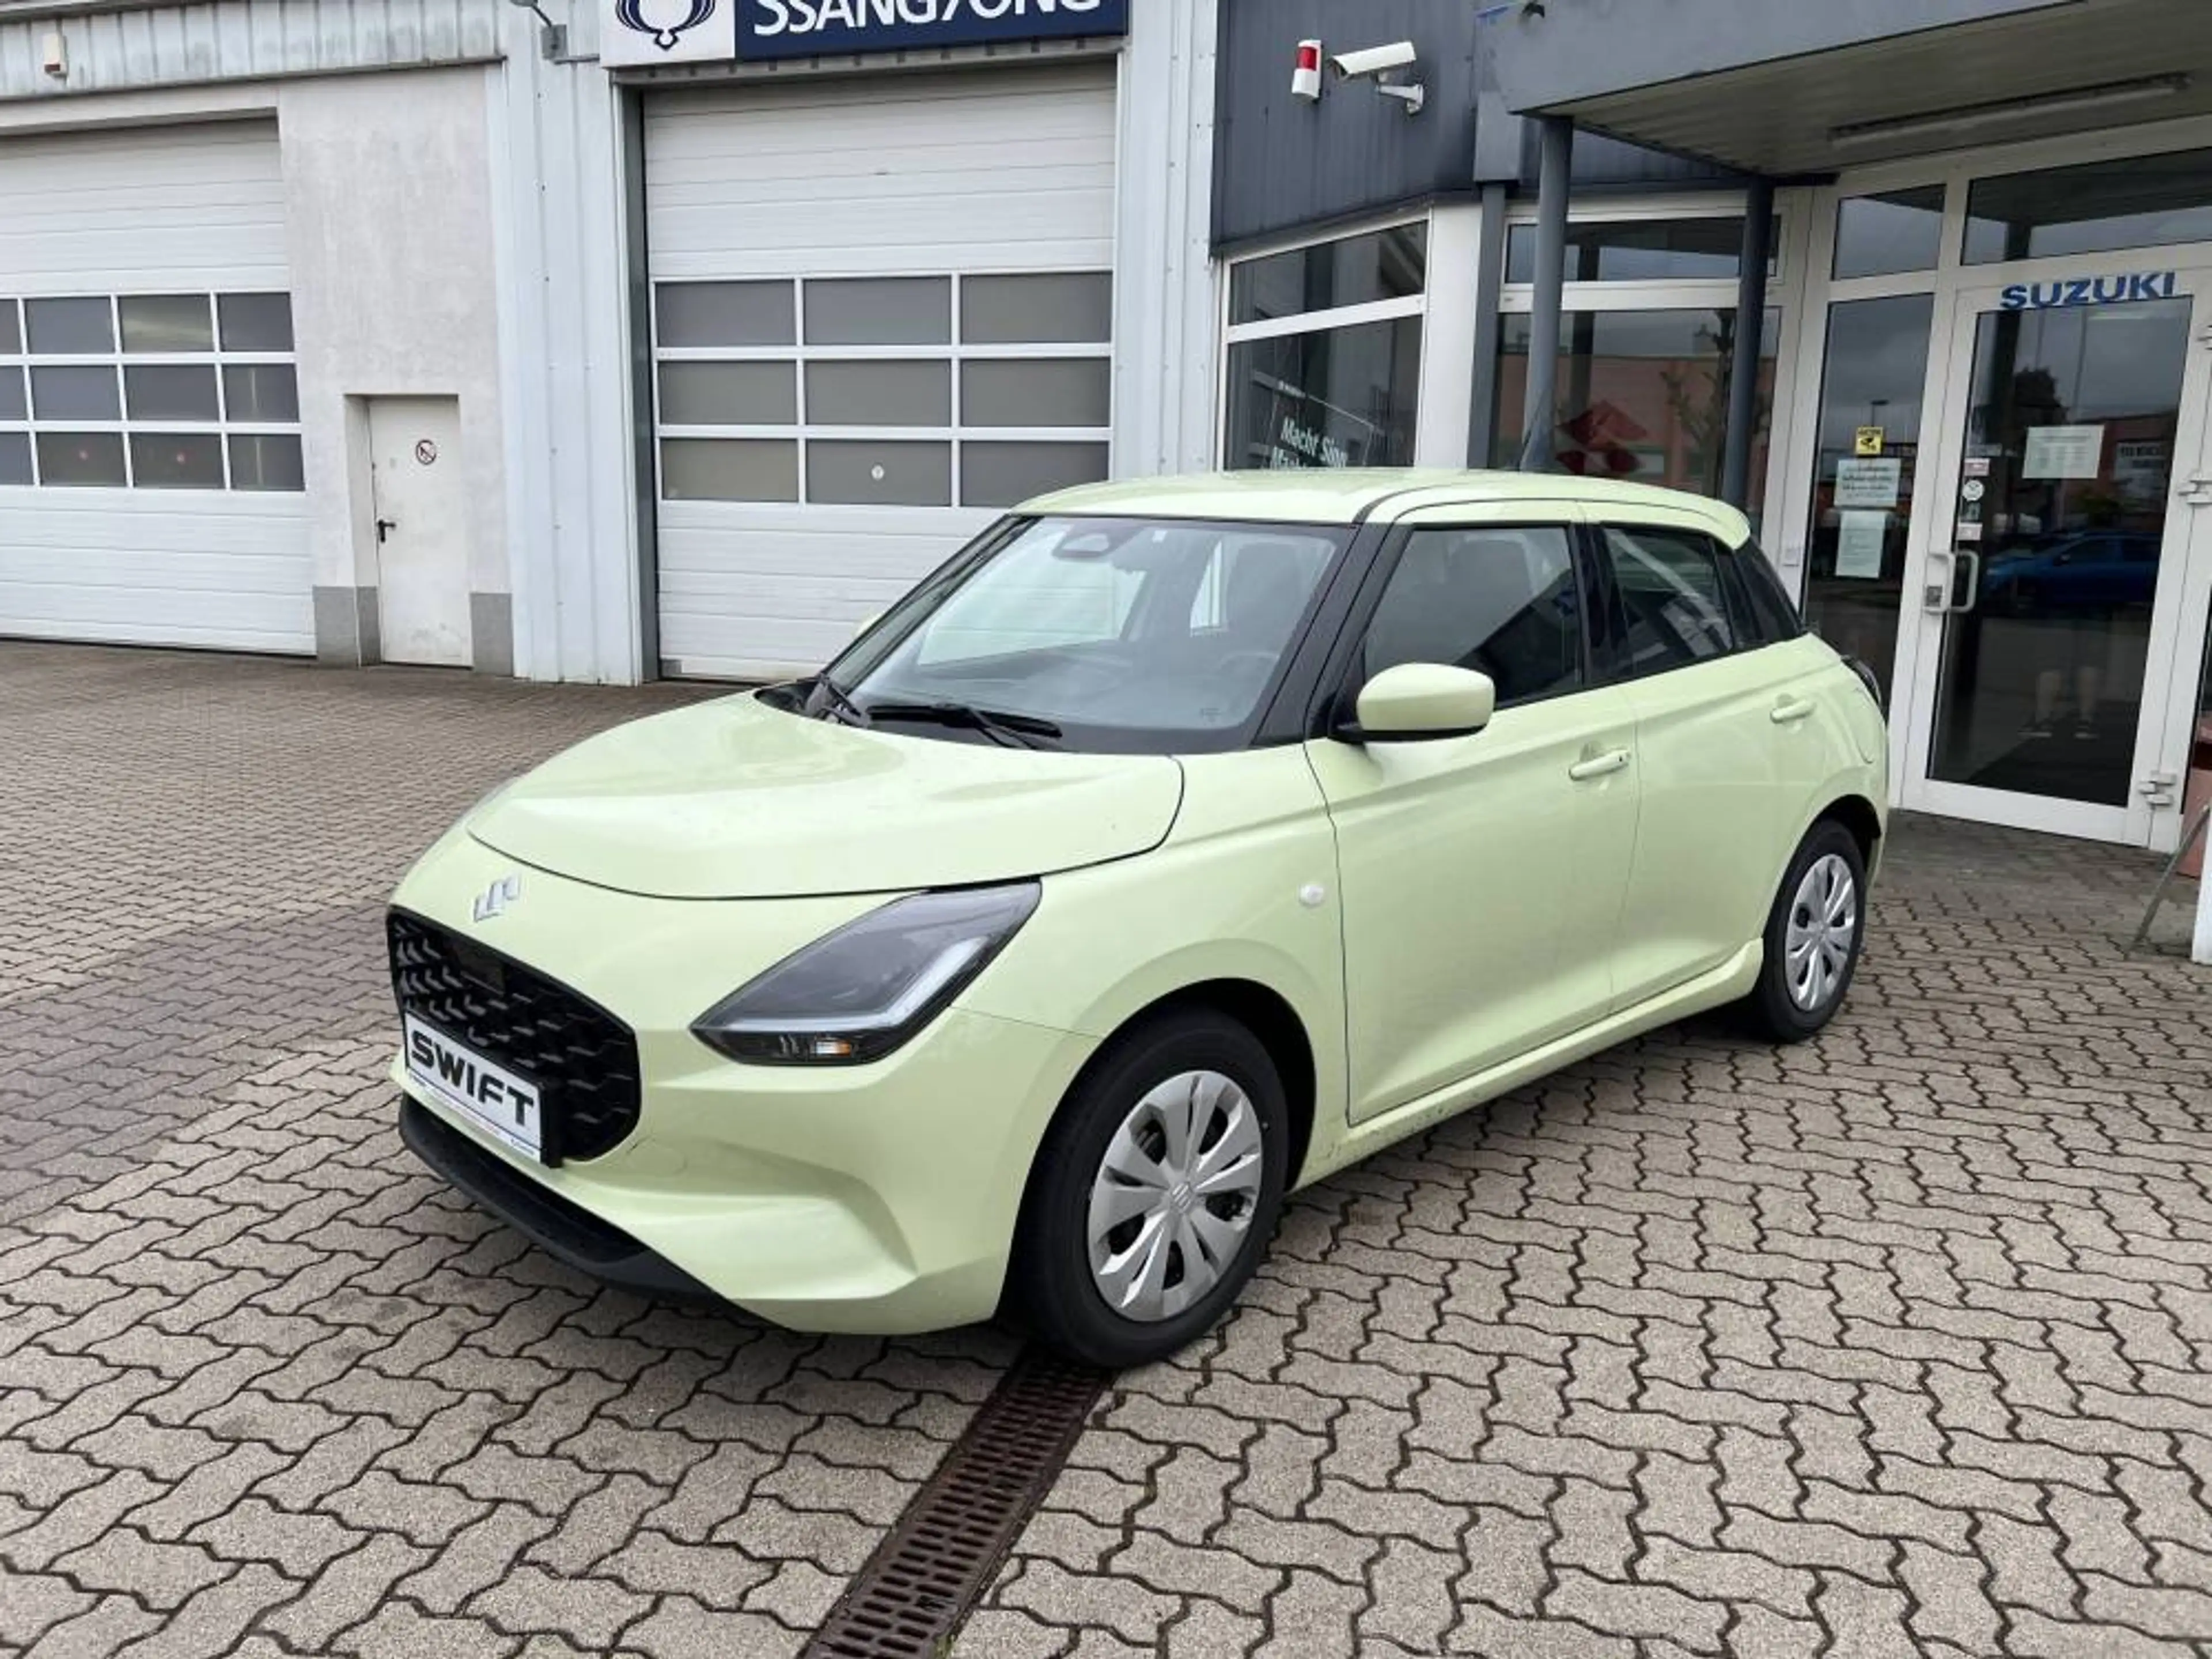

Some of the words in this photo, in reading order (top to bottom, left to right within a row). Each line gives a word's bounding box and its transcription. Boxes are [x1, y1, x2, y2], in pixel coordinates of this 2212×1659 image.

[753, 0, 1101, 35] SSANG
[2000, 272, 2175, 310] SUZUKI
[411, 1030, 533, 1126] SWIFT
